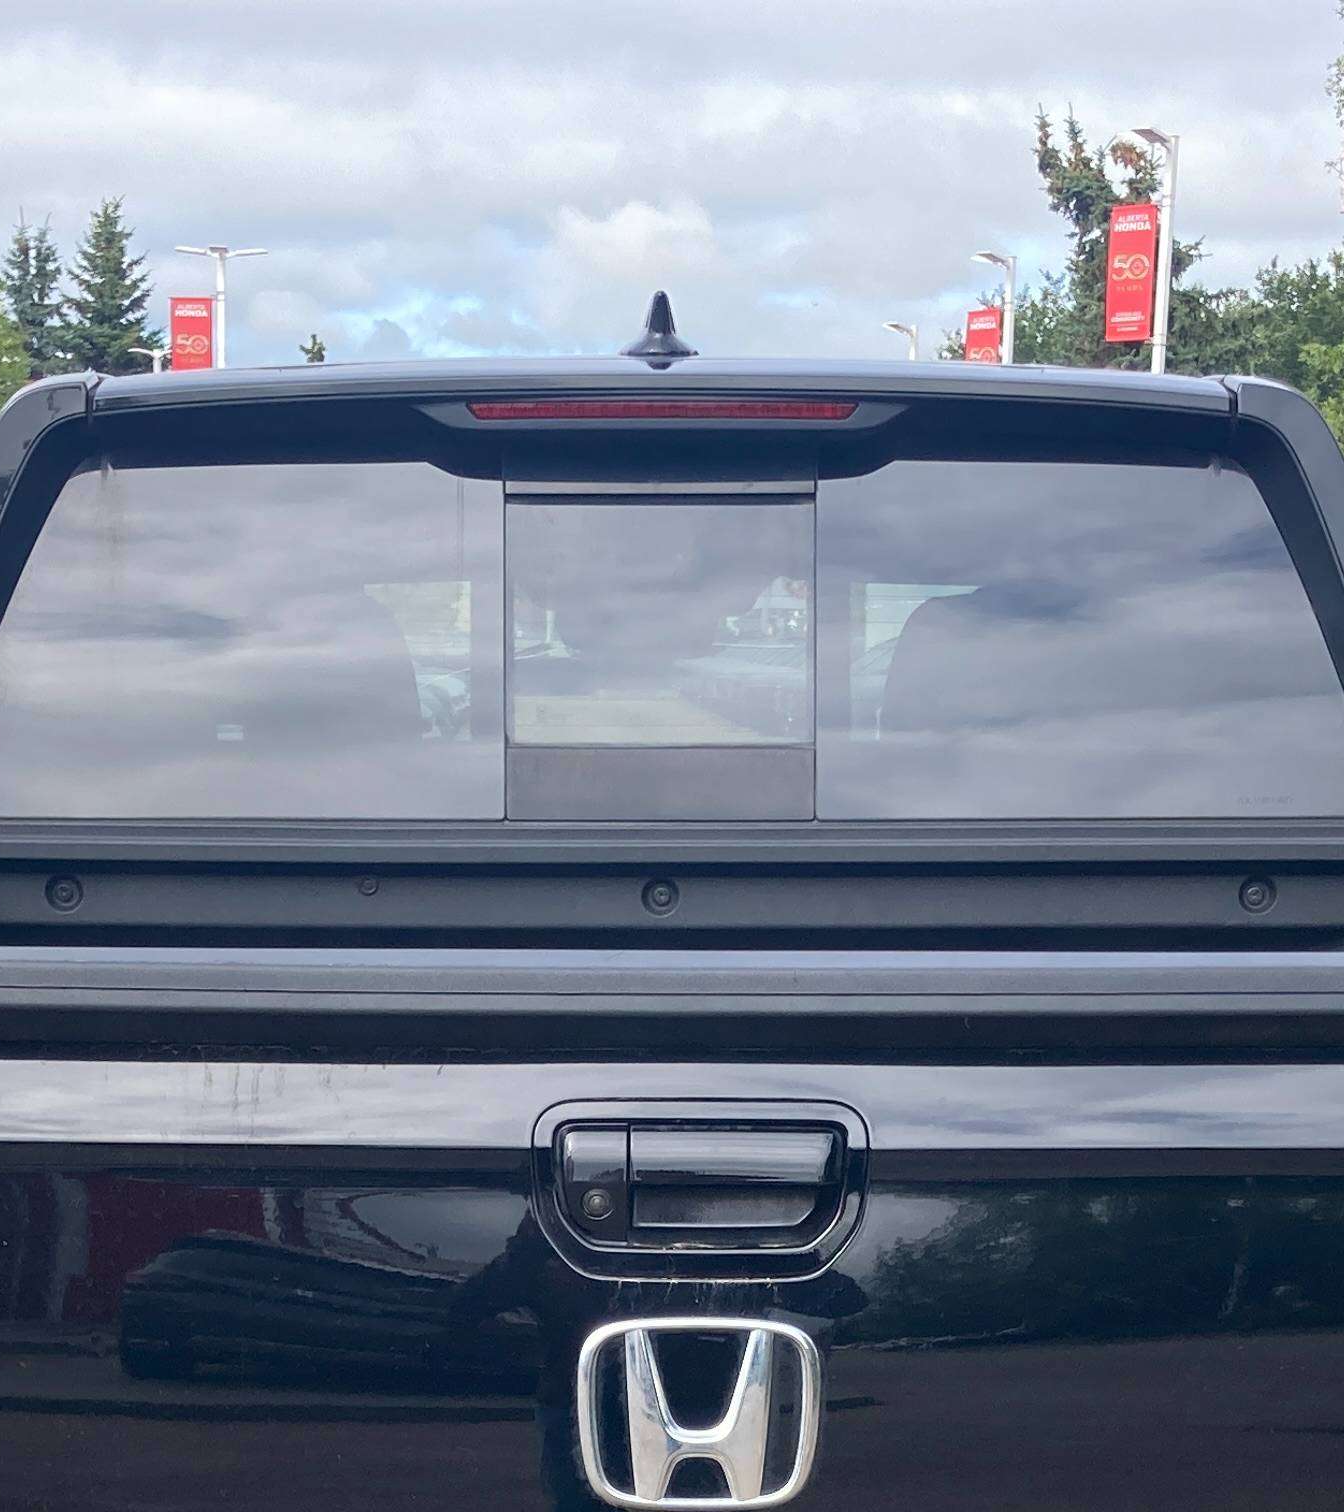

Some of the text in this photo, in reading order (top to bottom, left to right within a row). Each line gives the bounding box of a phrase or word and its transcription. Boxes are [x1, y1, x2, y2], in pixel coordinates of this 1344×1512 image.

[1113, 221, 1152, 232] HONDA
[1112, 254, 1150, 280] 50
[175, 309, 208, 317] HONDA
[176, 334, 209, 355] 50
